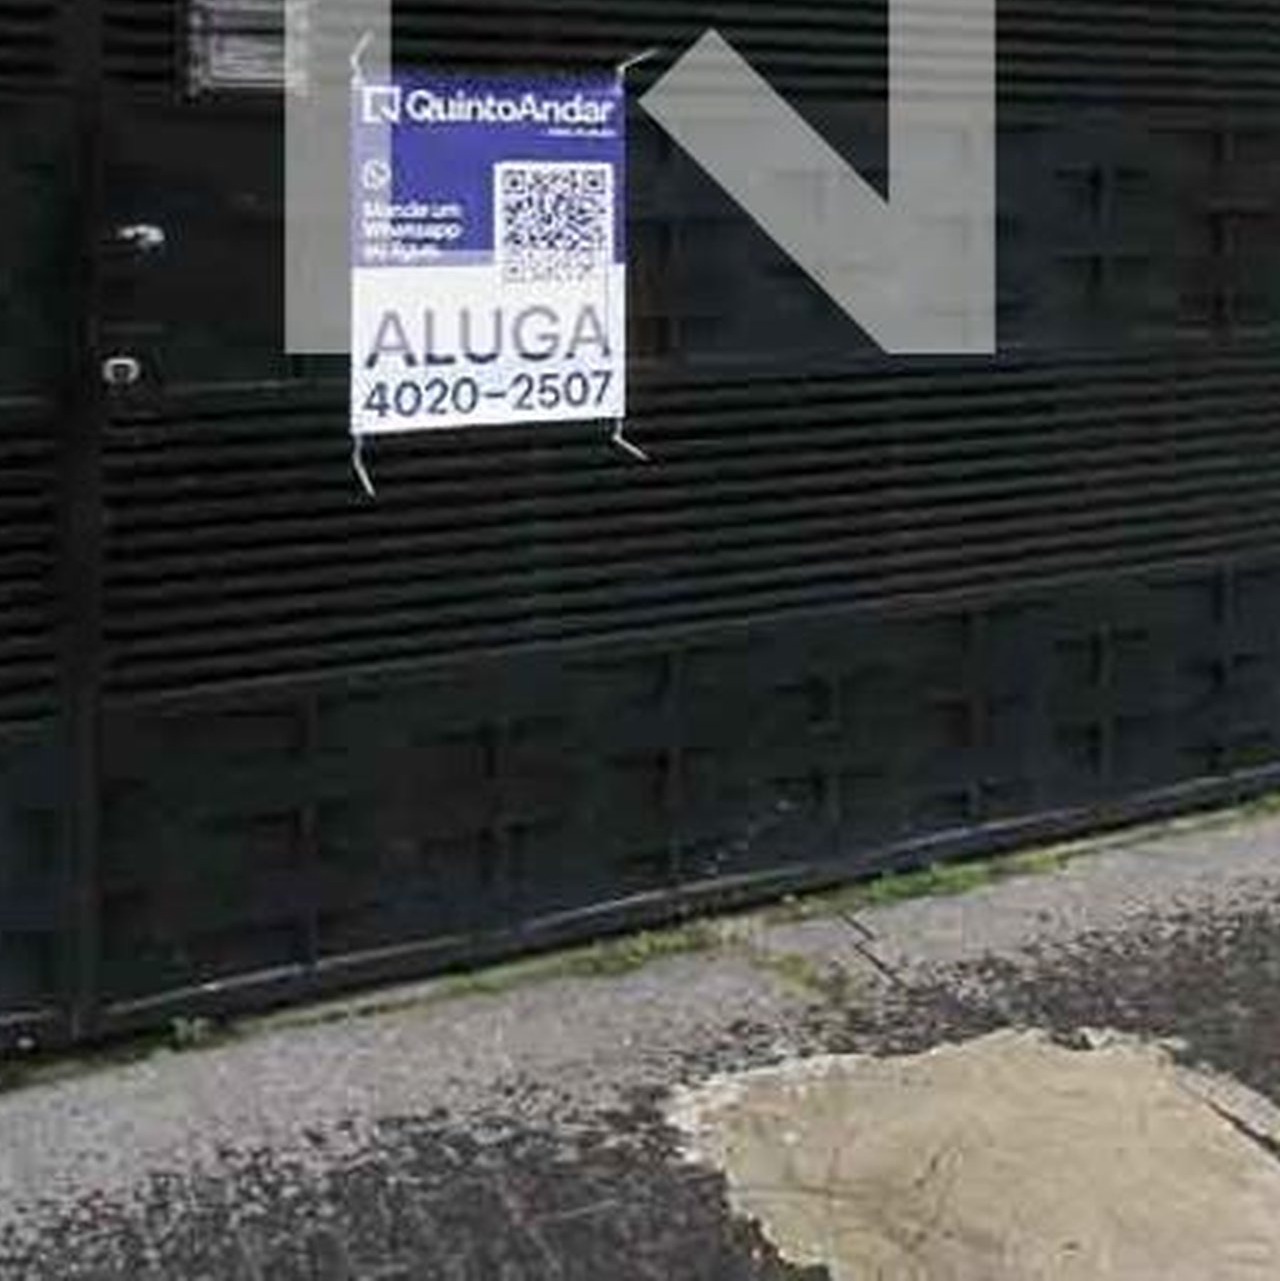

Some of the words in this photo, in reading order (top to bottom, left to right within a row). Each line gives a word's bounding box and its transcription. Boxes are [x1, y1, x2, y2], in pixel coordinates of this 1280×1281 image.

[406, 89, 614, 123] QuintoAndar
[366, 305, 611, 369] ALUGA
[363, 371, 614, 418] 4020-2507
